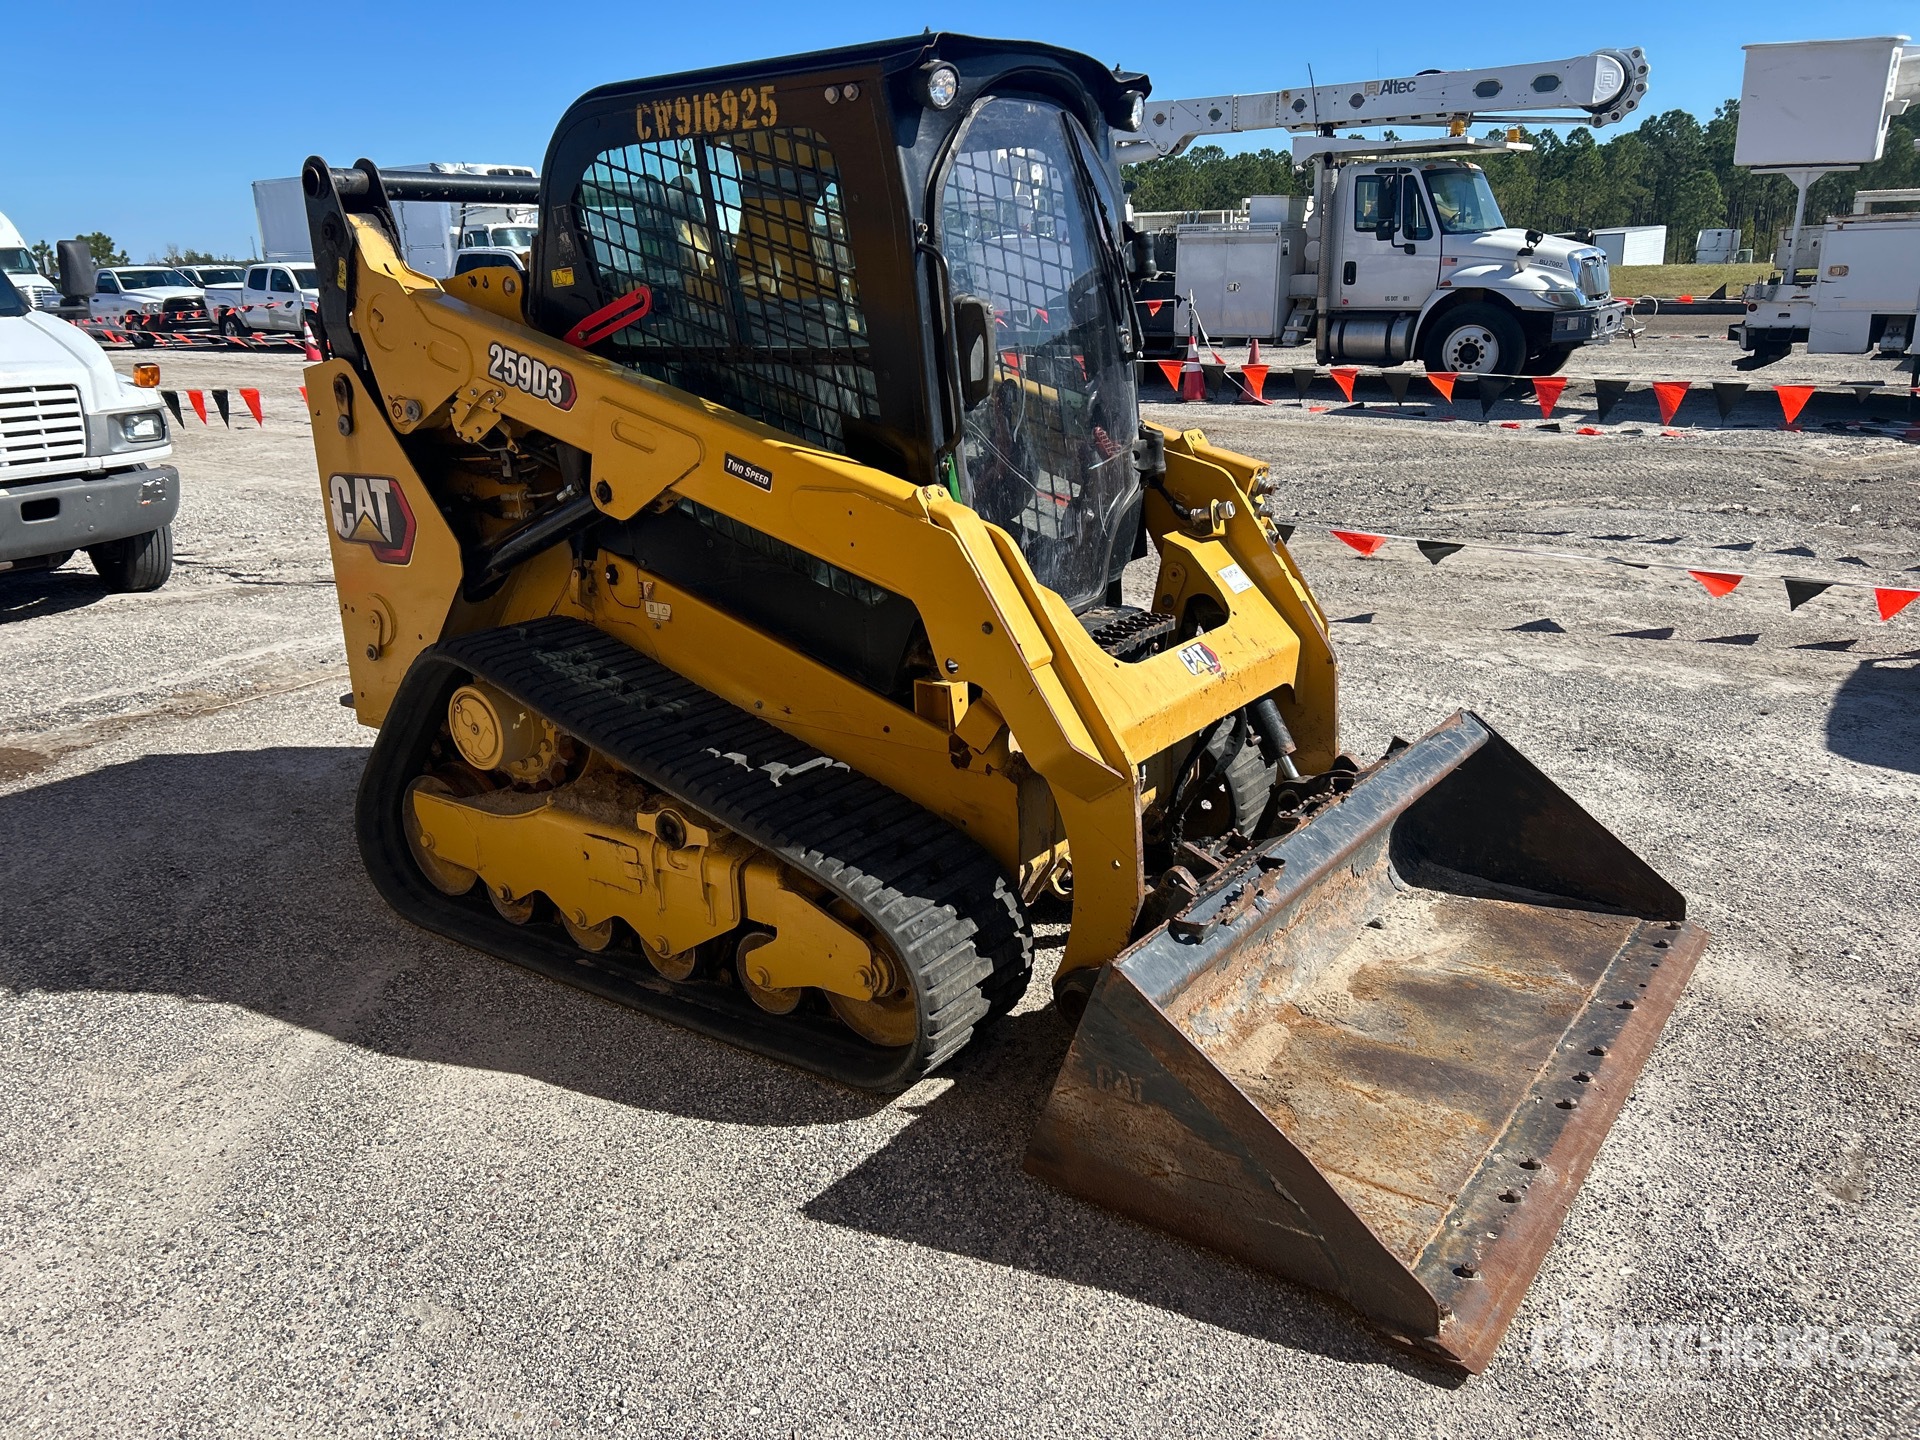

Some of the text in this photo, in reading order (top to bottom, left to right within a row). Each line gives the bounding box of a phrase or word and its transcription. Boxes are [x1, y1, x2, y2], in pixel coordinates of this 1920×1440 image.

[636, 86, 778, 140] CW916925
[1380, 79, 1416, 95] Altec
[488, 343, 562, 405] 259D3
[330, 475, 392, 543] CAT
[1177, 643, 1216, 676] CAT
